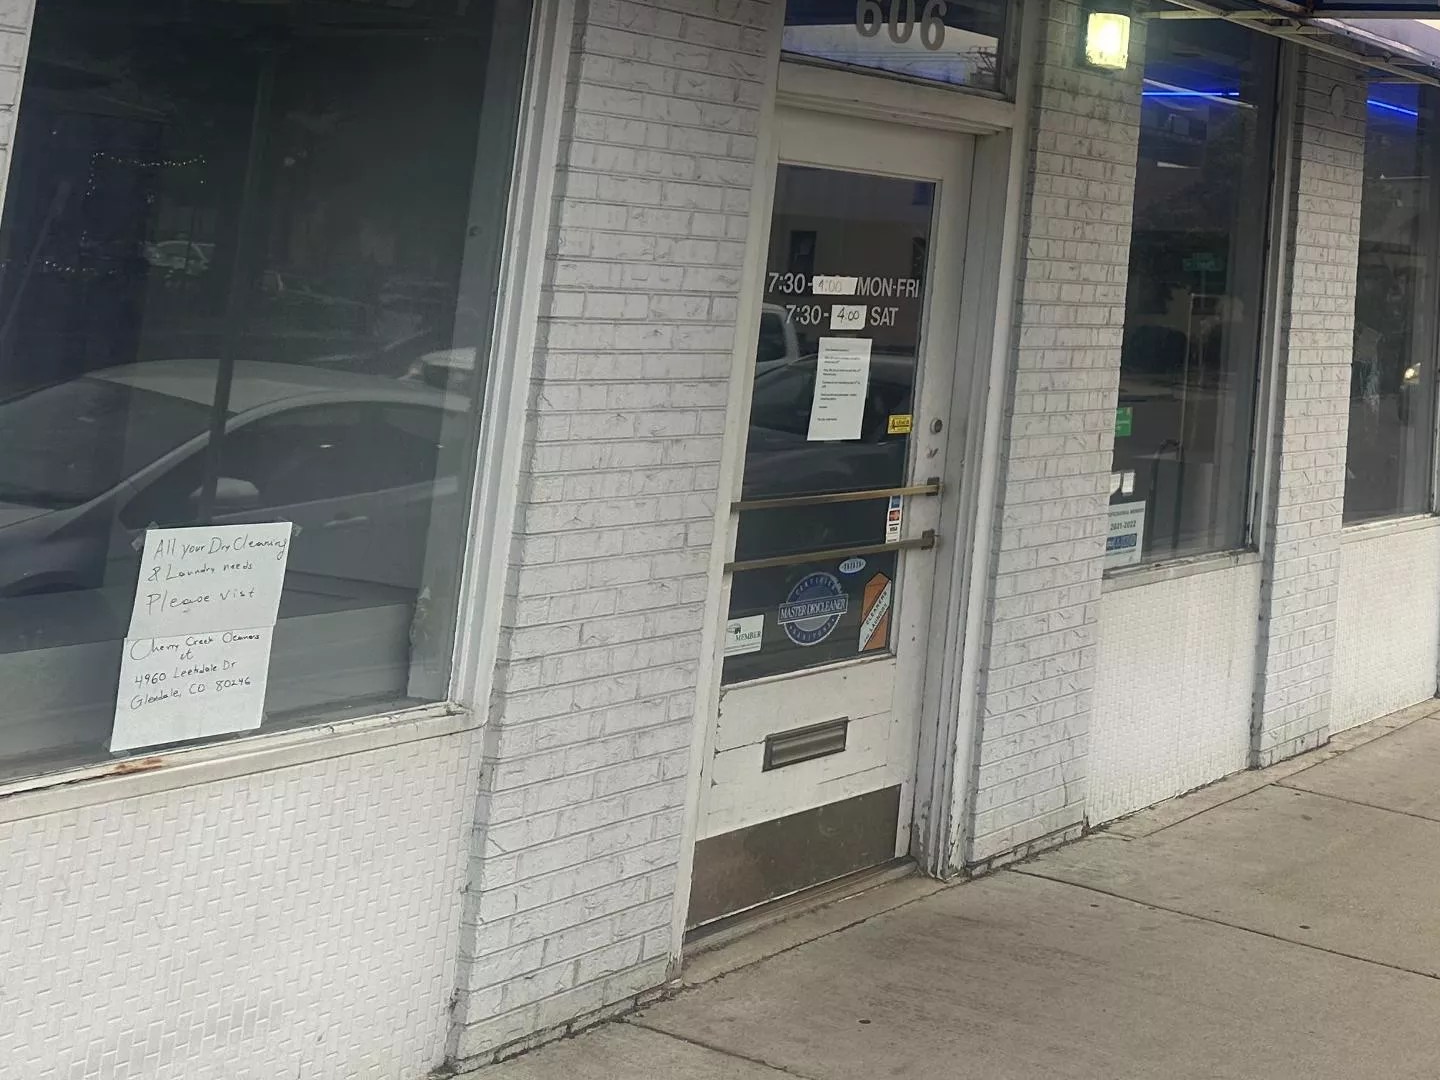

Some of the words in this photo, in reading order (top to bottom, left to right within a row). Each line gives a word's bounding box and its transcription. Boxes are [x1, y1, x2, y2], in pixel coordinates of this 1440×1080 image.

[870, 306, 899, 326] SAT
[153, 538, 177, 560] All
[181, 544, 205, 560] your
[208, 537, 232, 555] Dry
[233, 533, 287, 560] Cleaning
[166, 564, 215, 580] Laundry
[223, 561, 253, 571] needs
[146, 591, 210, 615] Please
[781, 604, 807, 619] MASTER
[735, 631, 761, 642] MEMBER
[130, 637, 179, 661] Cherry
[185, 636, 214, 647] Creek
[135, 672, 167, 688] 4960
[223, 659, 237, 670] Dr
[189, 683, 206, 694] CO
